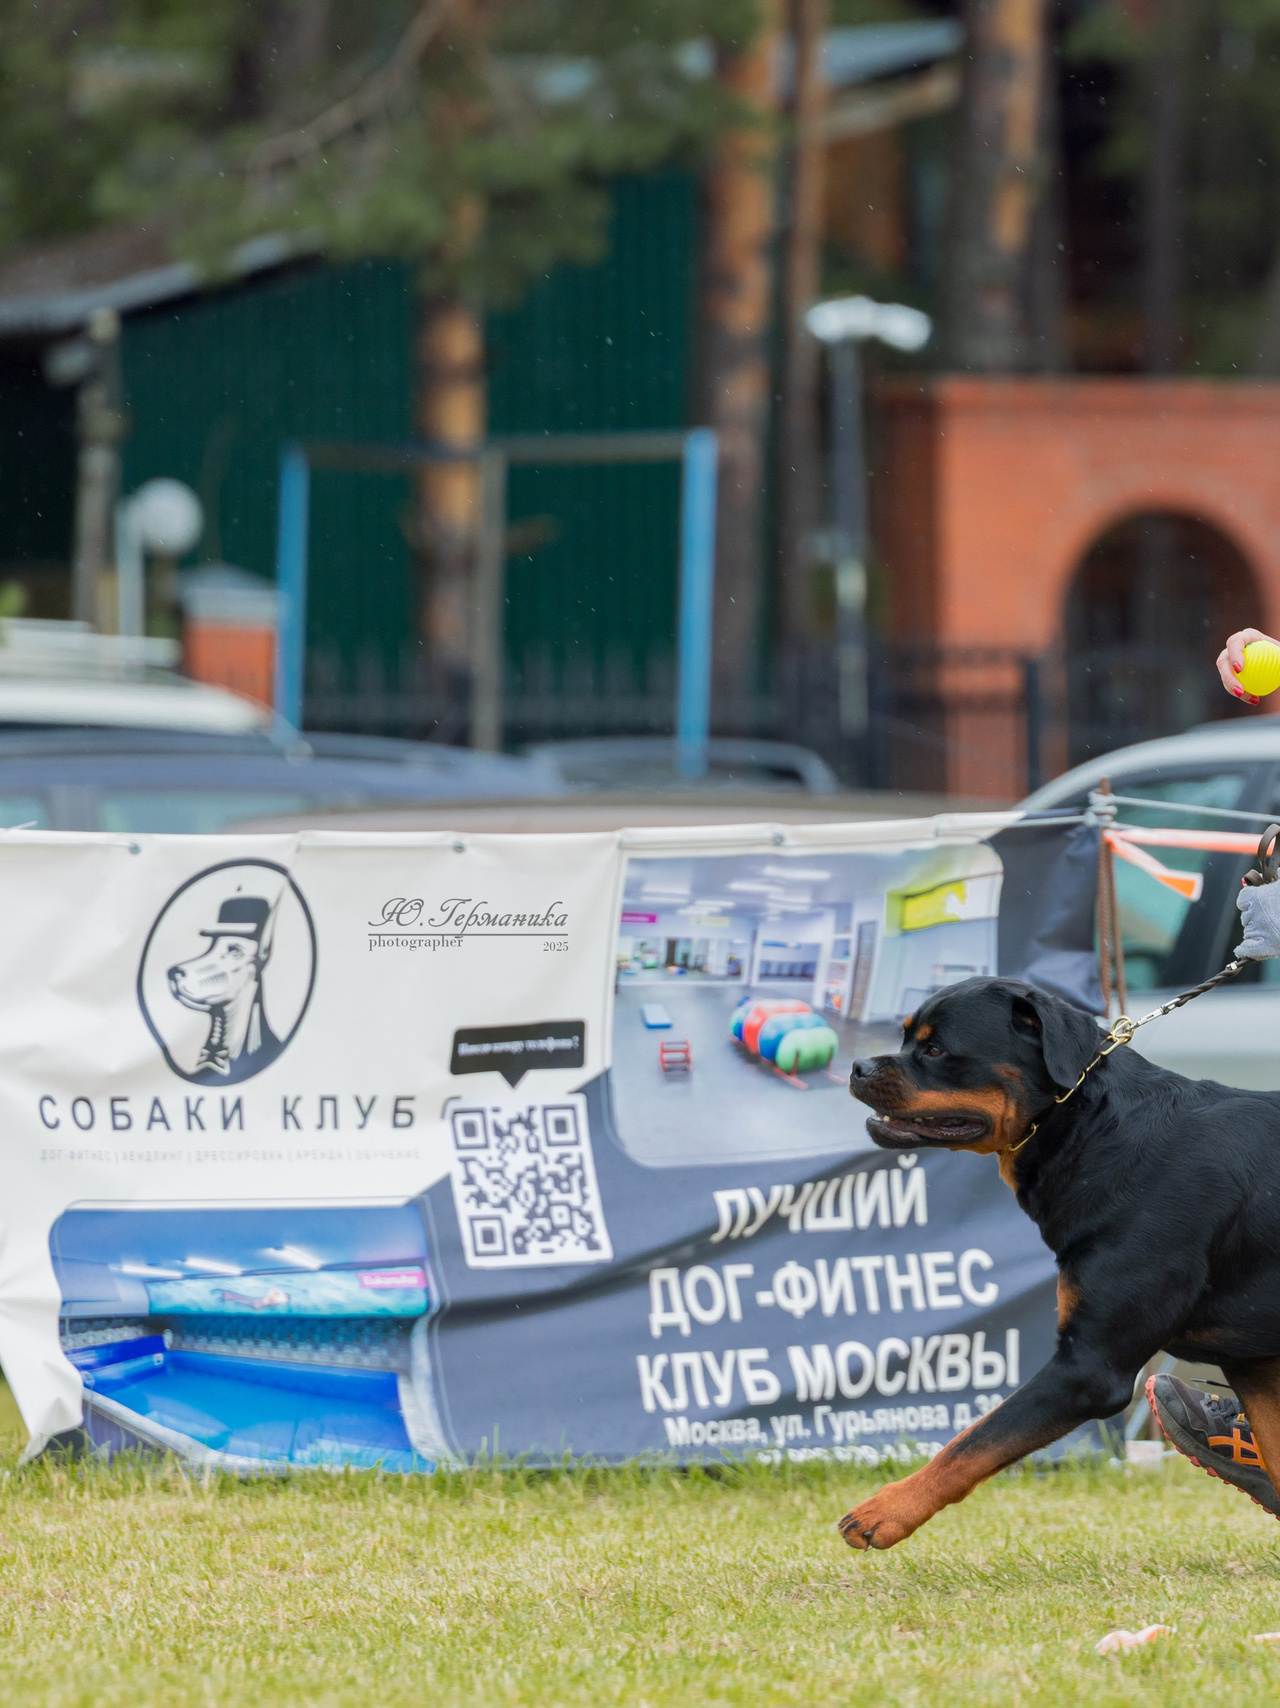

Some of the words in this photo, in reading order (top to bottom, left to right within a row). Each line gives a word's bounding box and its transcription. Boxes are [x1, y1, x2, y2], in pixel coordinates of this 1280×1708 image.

[38, 1094, 245, 1132] СОБАКИ
[282, 1095, 416, 1130] КЛУБ
[710, 1154, 928, 1244] ЛУЧШИЙ
[648, 1248, 999, 1338] ДОГ-ФИТНЕС
[636, 1347, 781, 1413] КЛУБ
[787, 1328, 1020, 1403] МОСКВЫ
[663, 1416, 768, 1447] Москва,
[769, 1413, 811, 1448] ул.
[813, 1404, 949, 1445] Гурьянова
